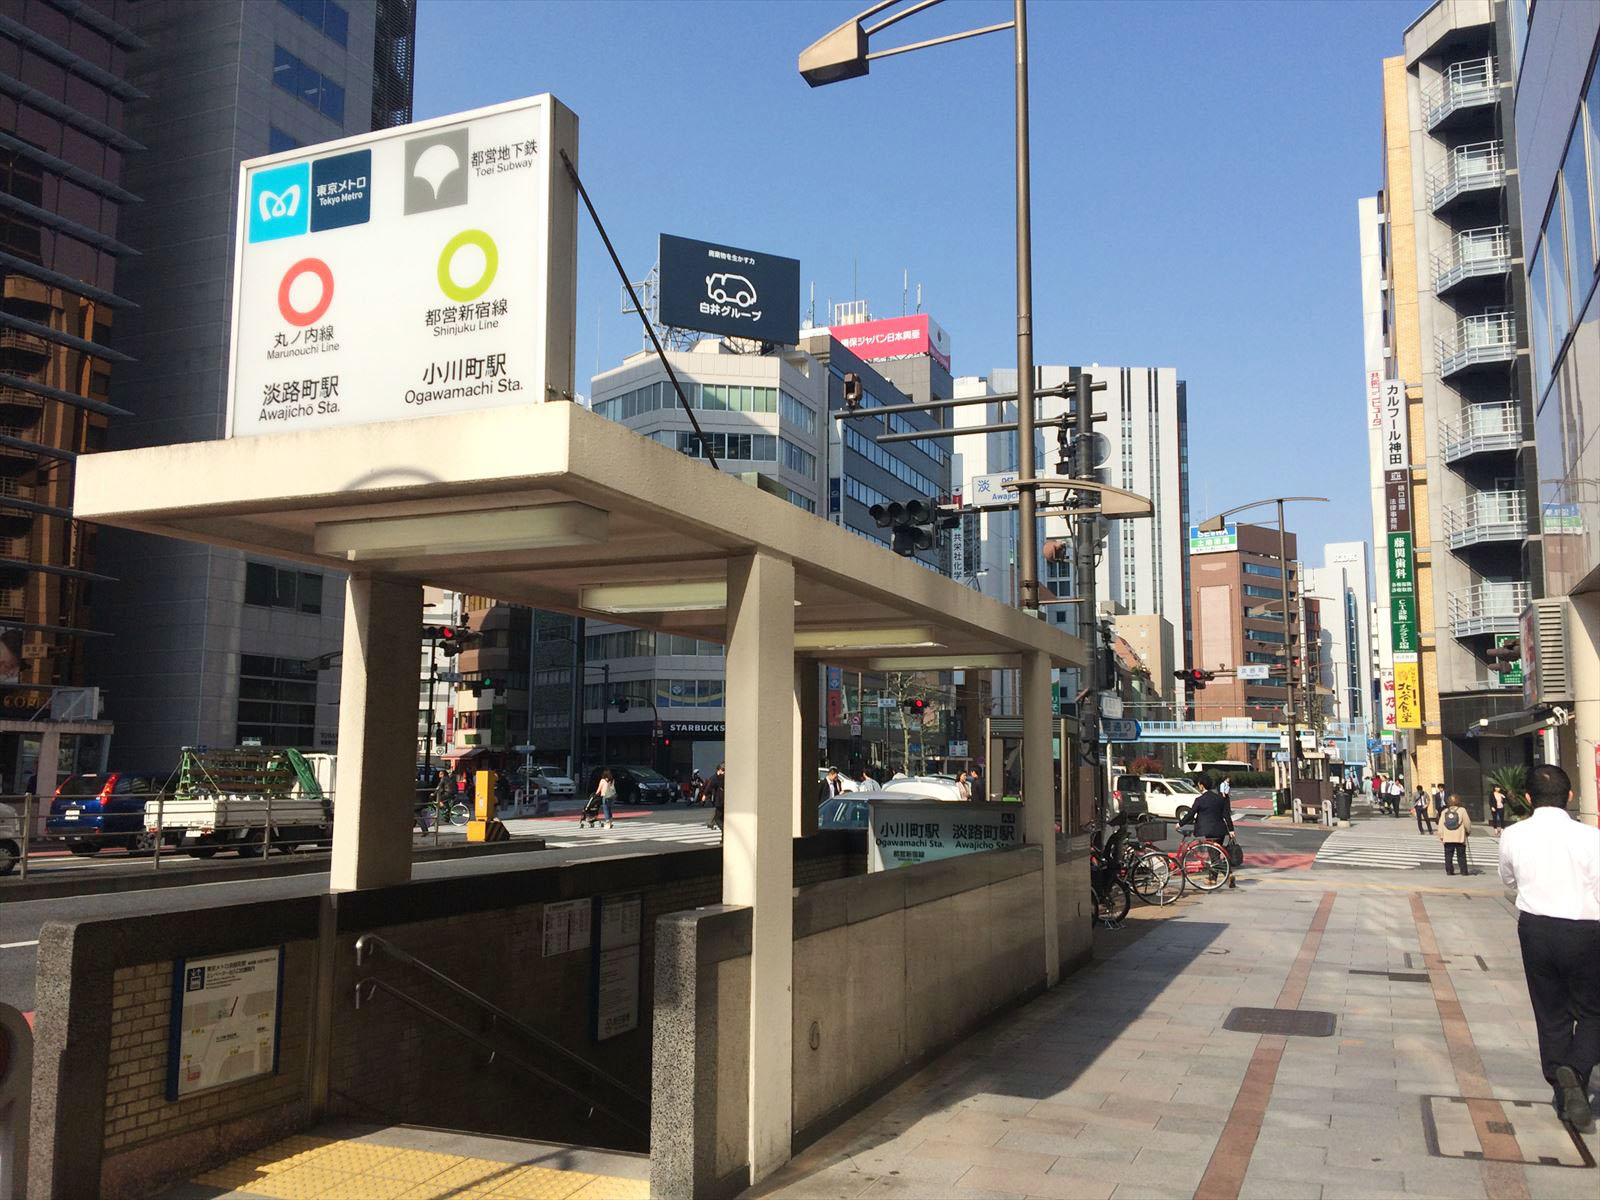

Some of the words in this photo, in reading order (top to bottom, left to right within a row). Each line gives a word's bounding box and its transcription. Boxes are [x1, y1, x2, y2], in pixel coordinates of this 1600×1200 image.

[471, 139, 538, 167] 都営地下鉄
[475, 167, 495, 177] Toei
[497, 159, 533, 173] Subway
[316, 176, 366, 197] 東京メトロ
[319, 196, 340, 206] Tokyo
[341, 191, 363, 202] Metro
[425, 298, 508, 326] 都営新宿線
[699, 301, 762, 322] 白井グループ
[273, 325, 334, 348] 丸ノ内線
[433, 323, 476, 337] Shinjuku
[478, 320, 499, 330] Line
[267, 345, 319, 359] Marunouchi
[321, 342, 340, 352] Line
[422, 353, 506, 385] 小川町駅
[263, 375, 339, 406] 淡路町駅
[404, 380, 493, 405] Ogawamachi
[497, 378, 523, 393] Sta.
[317, 400, 340, 414] Sta.
[1387, 385, 1402, 465] カルフール神田
[670, 724, 725, 732] STARBUCKS
[880, 822, 940, 839] 小川町駅
[952, 823, 1016, 841] 淡路町駅
[876, 839, 927, 848] Ogawamachi
[929, 839, 944, 848] Sta.
[955, 841, 994, 850] Awajicho
